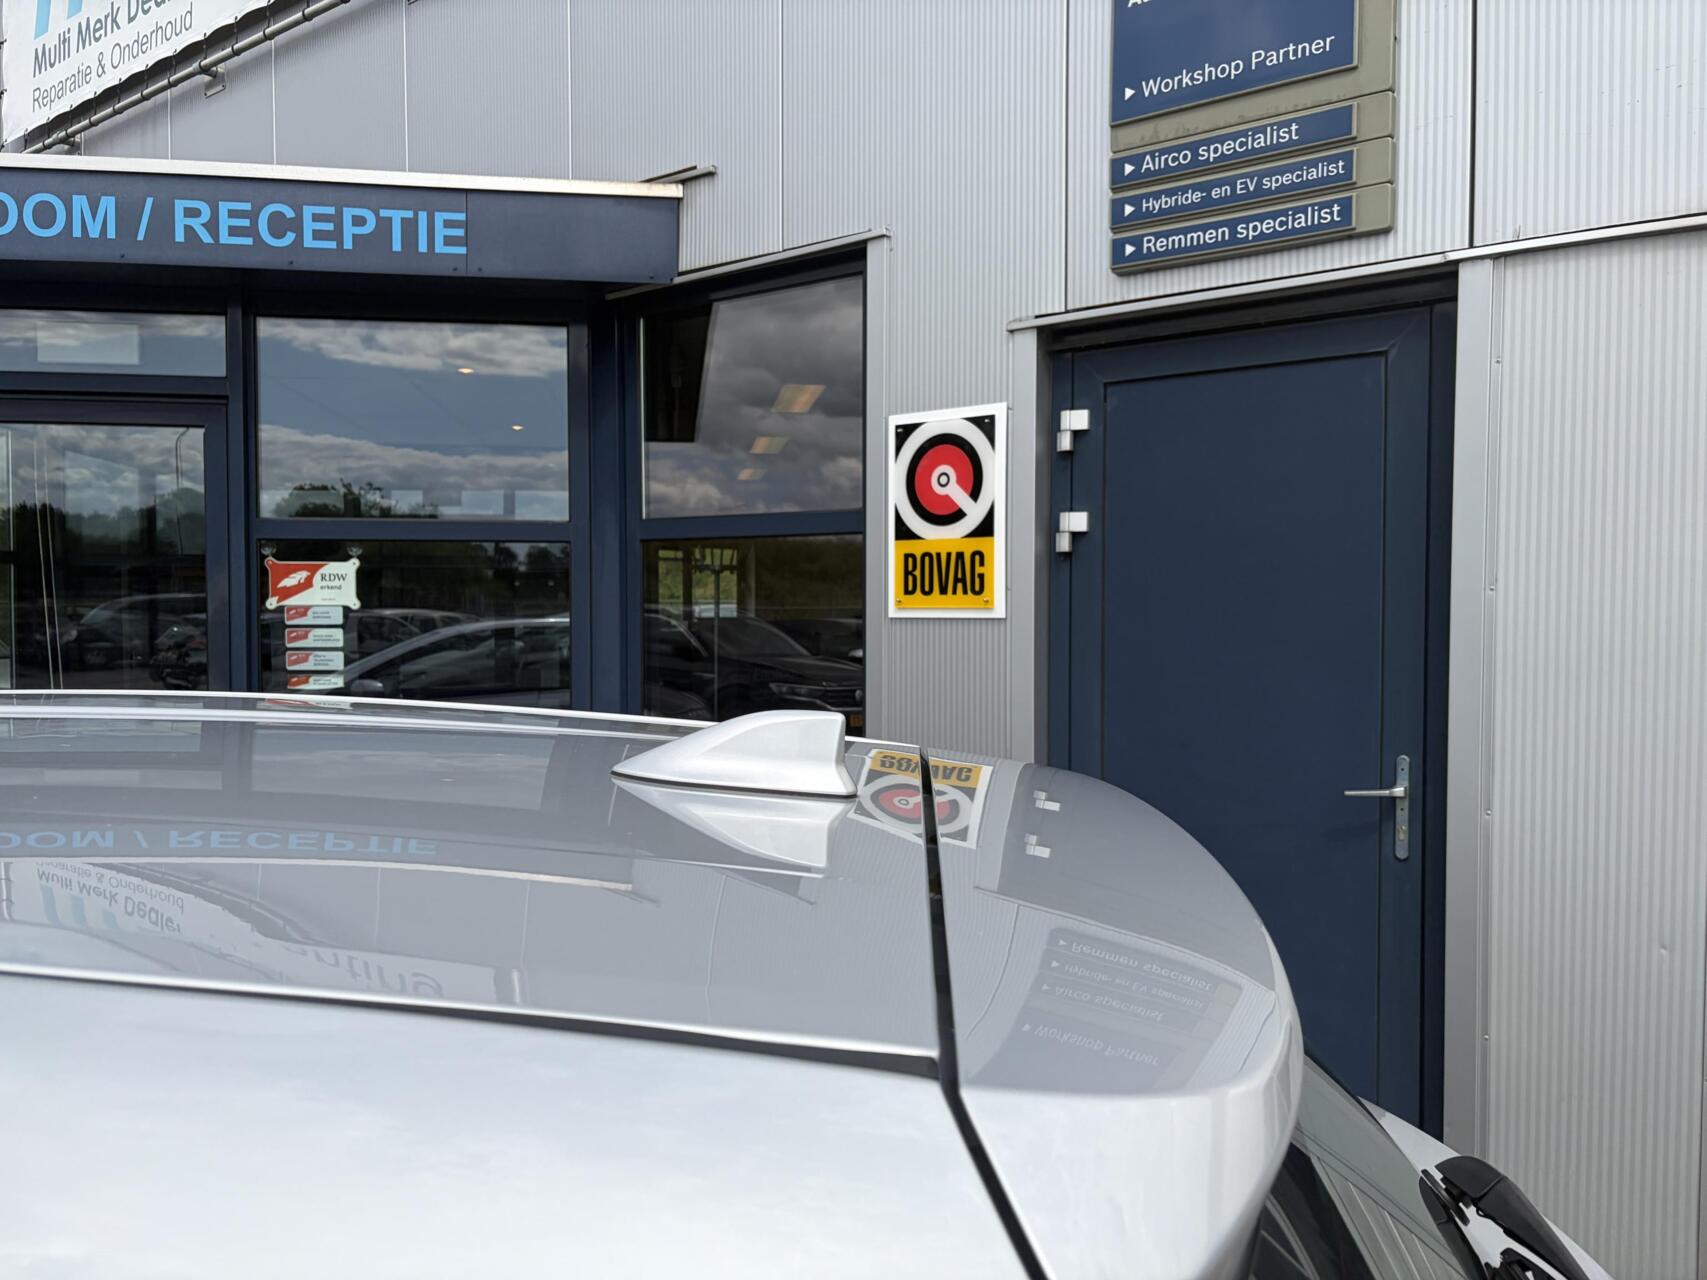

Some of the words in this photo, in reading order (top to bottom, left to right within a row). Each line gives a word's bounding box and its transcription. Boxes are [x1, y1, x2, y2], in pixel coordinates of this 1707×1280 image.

[32, 62, 93, 112] Reparatie
[96, 51, 106, 78] &
[110, 2, 193, 69] Onderhoud
[33, 27, 71, 78] Multi
[76, 1, 121, 53] Merk
[1142, 59, 1244, 98] Workshop
[1251, 36, 1335, 70] Partner
[1141, 149, 1192, 174] Airco
[1198, 122, 1299, 162] specialist
[1142, 188, 1207, 214] Hybride-
[1211, 185, 1231, 199] en
[1236, 177, 1258, 195] EV
[1262, 160, 1345, 191] specialist
[136, 197, 154, 241] /
[174, 199, 467, 255] RECEPTIE
[1143, 227, 1229, 254] Remmen
[1236, 203, 1341, 241] specialist
[320, 573, 348, 582] RDW
[903, 550, 985, 596] BOVAG
